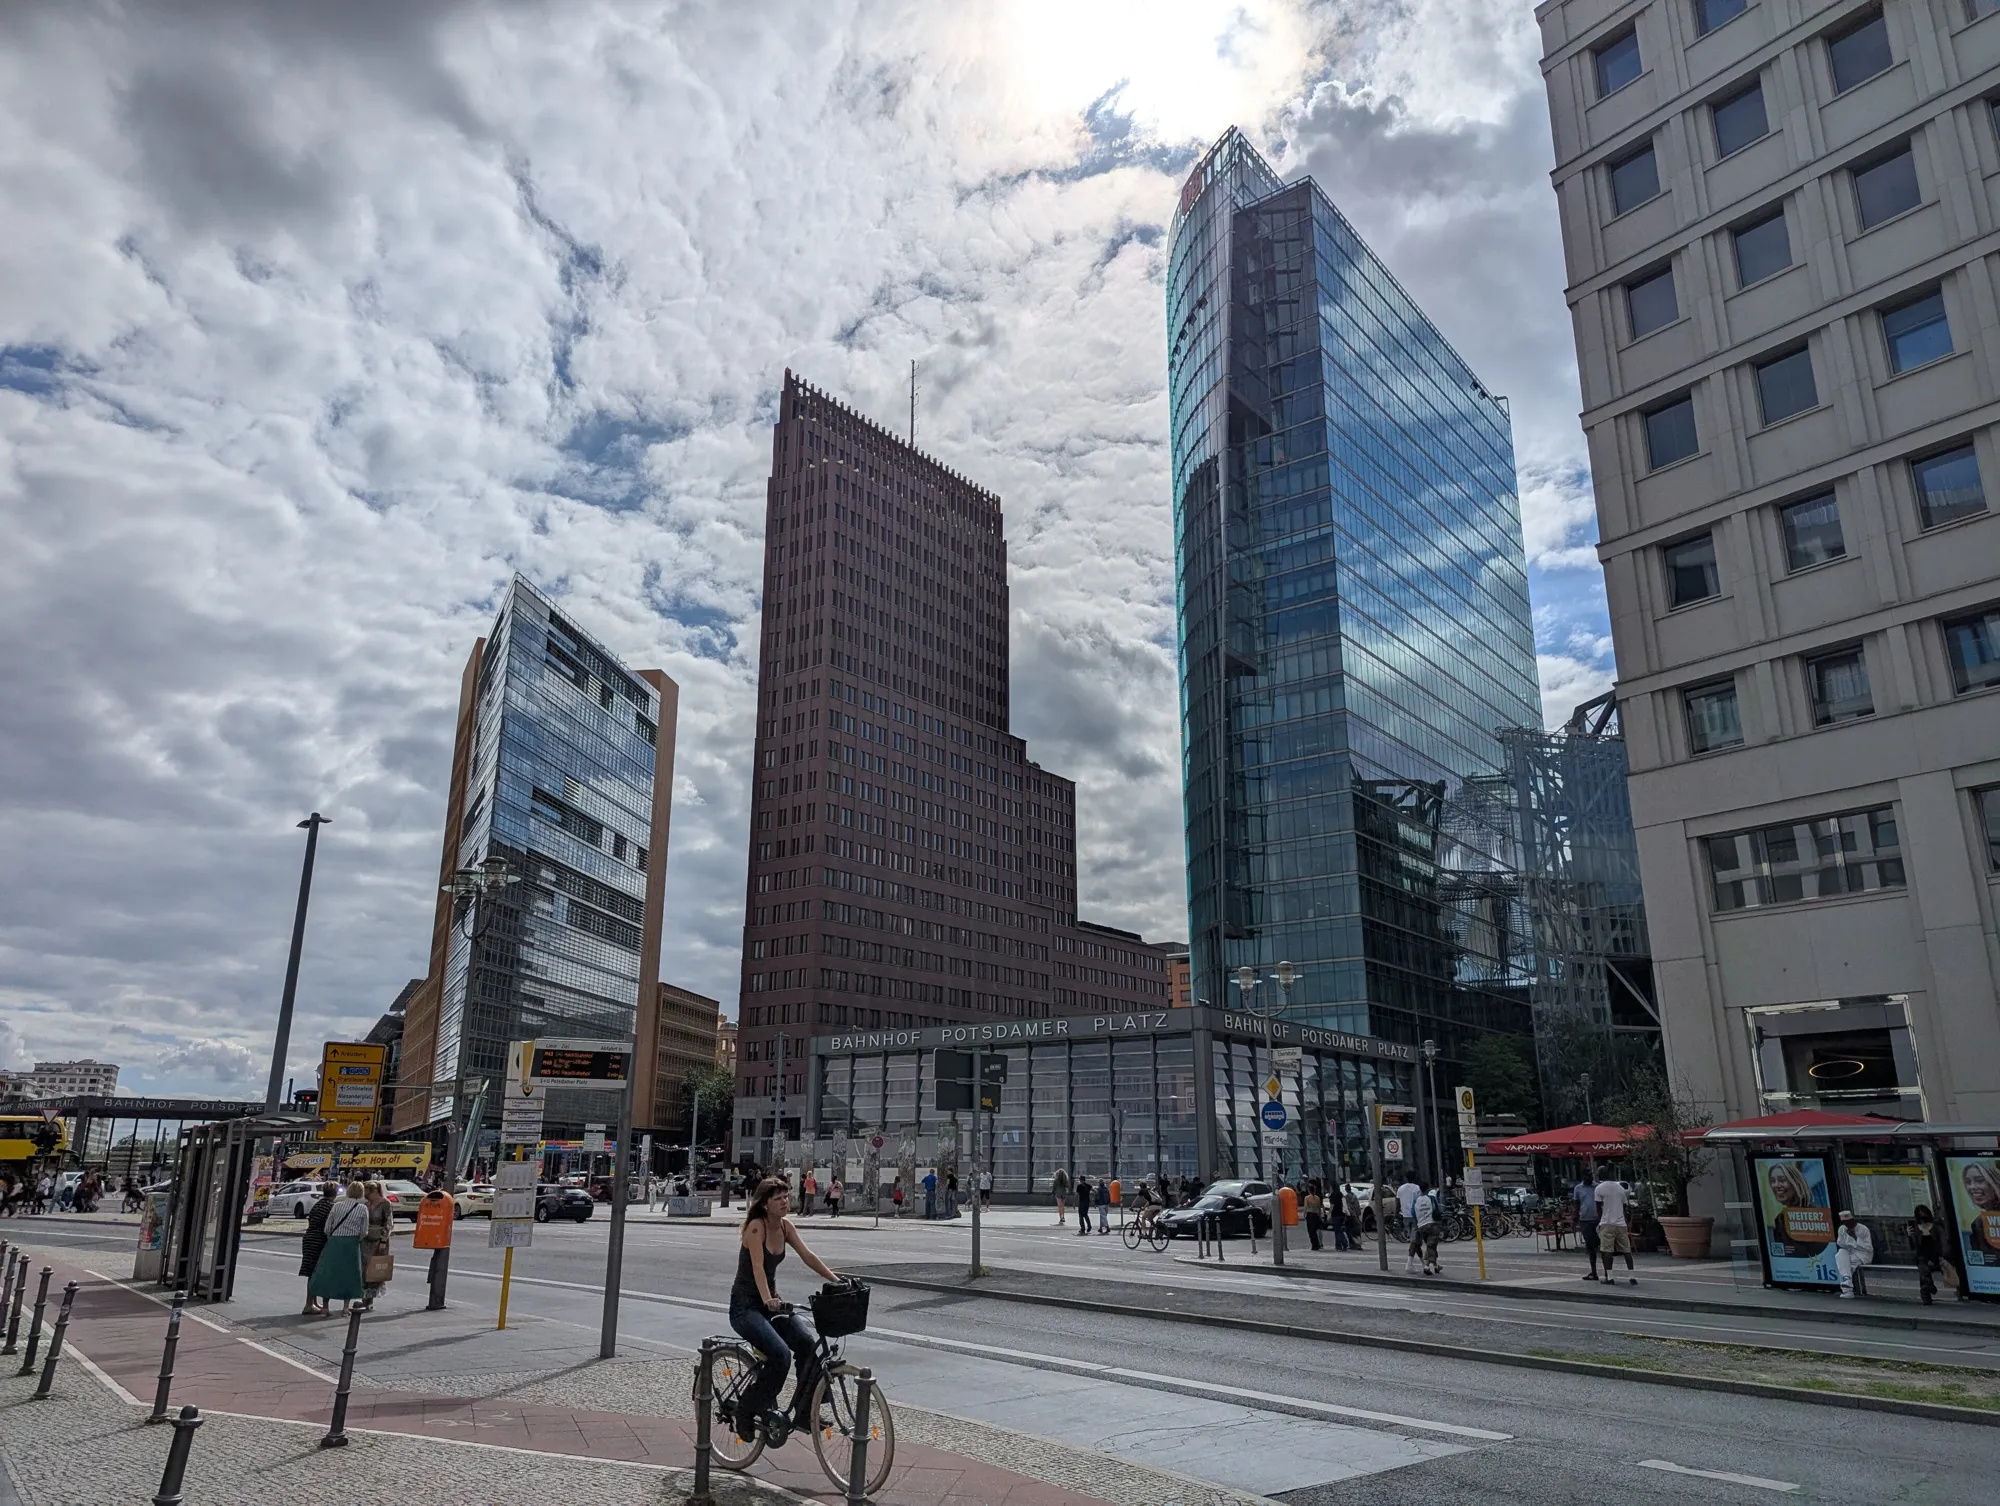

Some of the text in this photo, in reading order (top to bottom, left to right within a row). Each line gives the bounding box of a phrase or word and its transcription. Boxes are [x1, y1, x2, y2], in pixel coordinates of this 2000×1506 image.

[830, 1013, 1169, 1050] BAHNHOF POTSDAMER PLATZ
[1301, 1028, 1369, 1052] POTSDAMER
[1378, 1042, 1409, 1059] PLATZ
[338, 1092, 373, 1100] Alexanderplatz
[17, 1100, 52, 1111] POTSDAMER
[55, 1098, 75, 1108] PLATZ
[104, 1098, 176, 1109] BAHNHOF
[1389, 1143, 1397, 1151] 30
[1504, 1143, 1549, 1152] VAPIANO
[370, 1156, 387, 1165] Hop
[388, 1154, 401, 1163] off
[1788, 1211, 1824, 1221] WEITER?
[1789, 1221, 1830, 1232] BILDUNG!
[1816, 1264, 1838, 1281] ils
